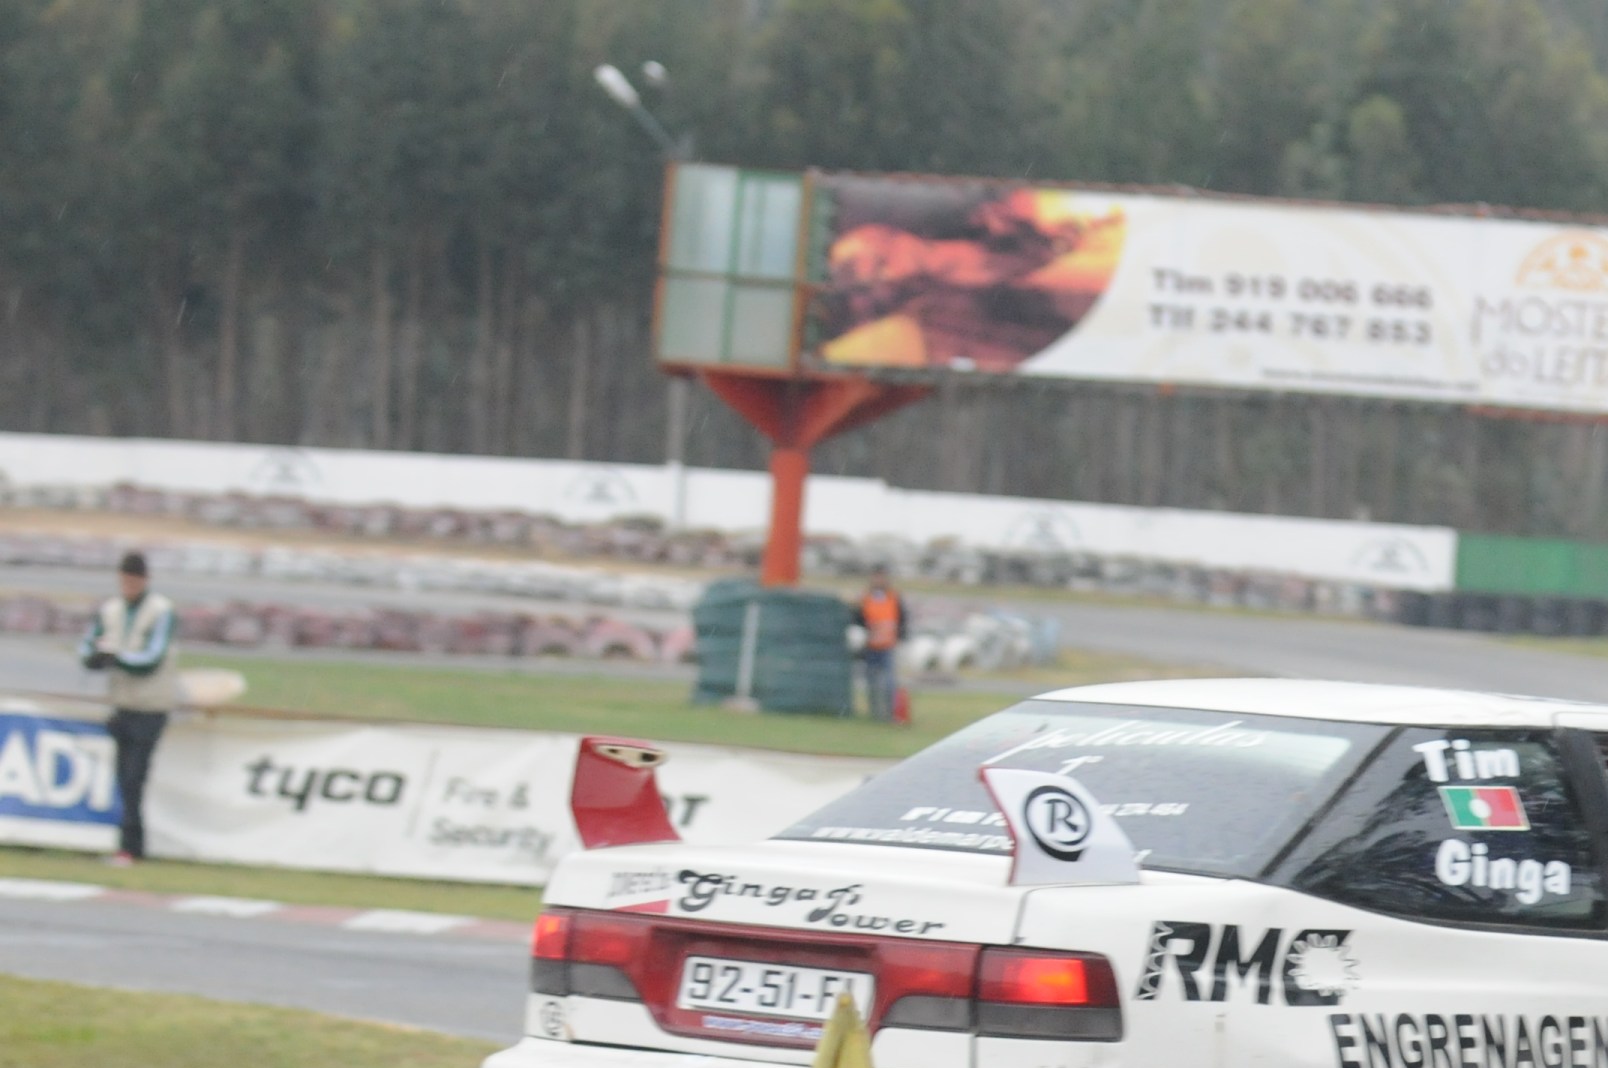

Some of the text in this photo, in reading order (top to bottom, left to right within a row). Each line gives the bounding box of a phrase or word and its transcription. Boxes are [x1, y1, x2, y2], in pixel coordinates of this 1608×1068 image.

[0, 728, 119, 812] ADT
[245, 755, 406, 814] tyco
[1411, 739, 1520, 782] Tim
[443, 776, 531, 809] Fire &
[429, 816, 556, 857] Security
[677, 869, 817, 912] Ginga
[1434, 839, 1572, 904] Ginga
[1137, 920, 1357, 1007] RMC
